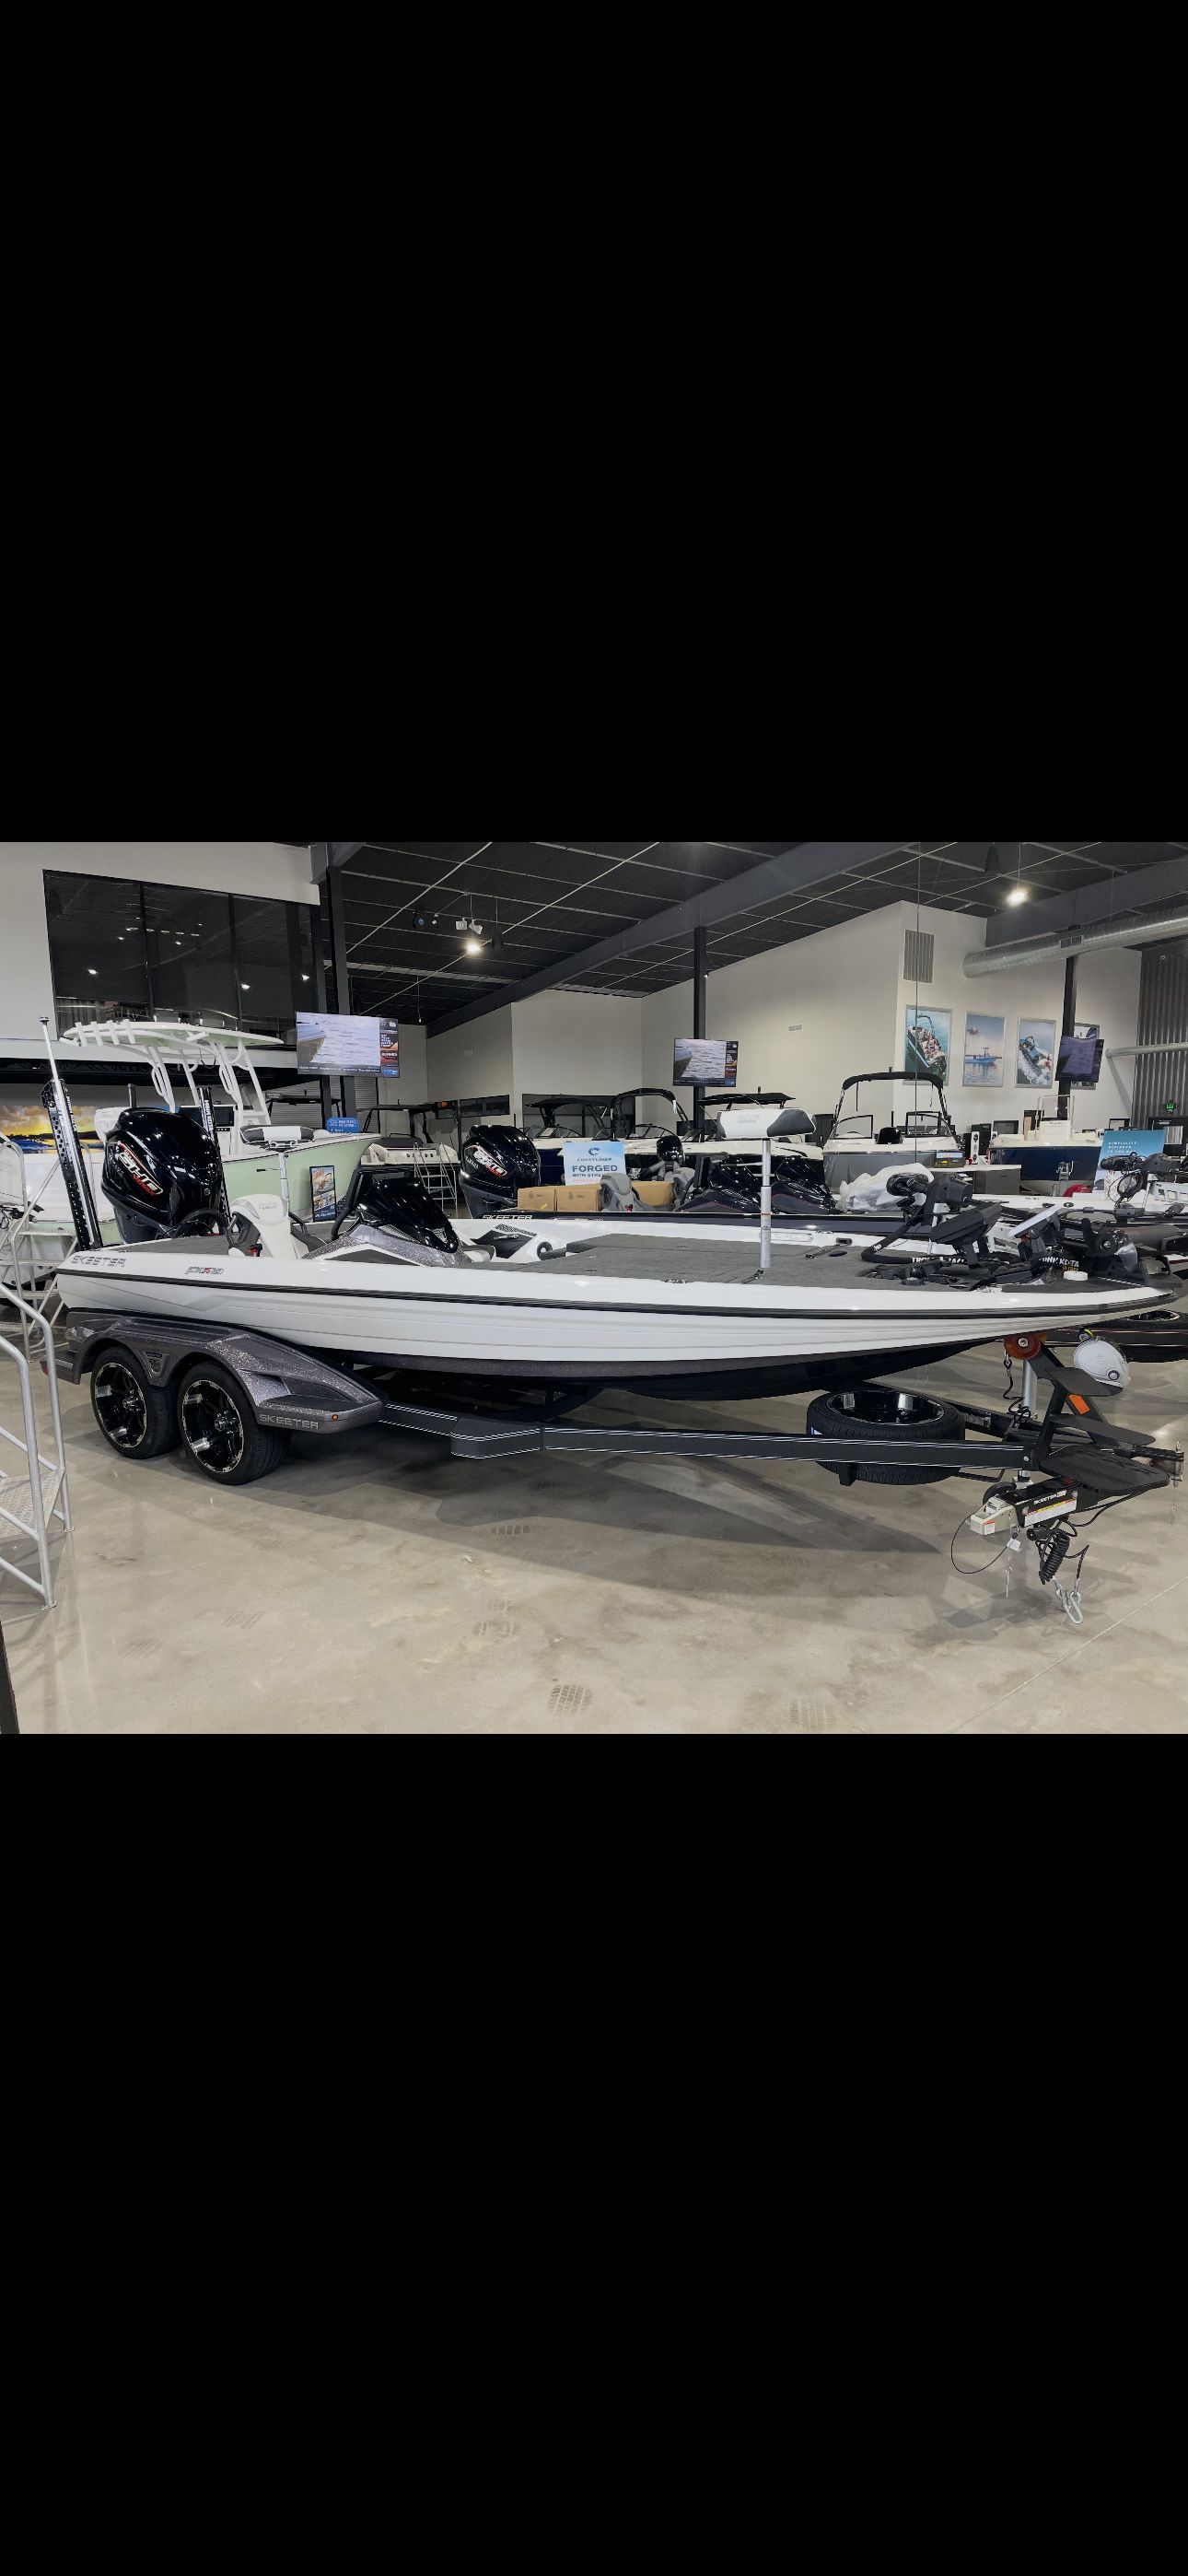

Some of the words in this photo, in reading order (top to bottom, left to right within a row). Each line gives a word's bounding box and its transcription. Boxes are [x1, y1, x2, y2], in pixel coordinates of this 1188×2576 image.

[118, 1152, 164, 1195] SHO
[572, 1165, 618, 1173] FORGED
[71, 1255, 127, 1268] SKEETER
[1059, 1258, 1080, 1268] KOTA
[259, 1413, 319, 1430] SKEETER
